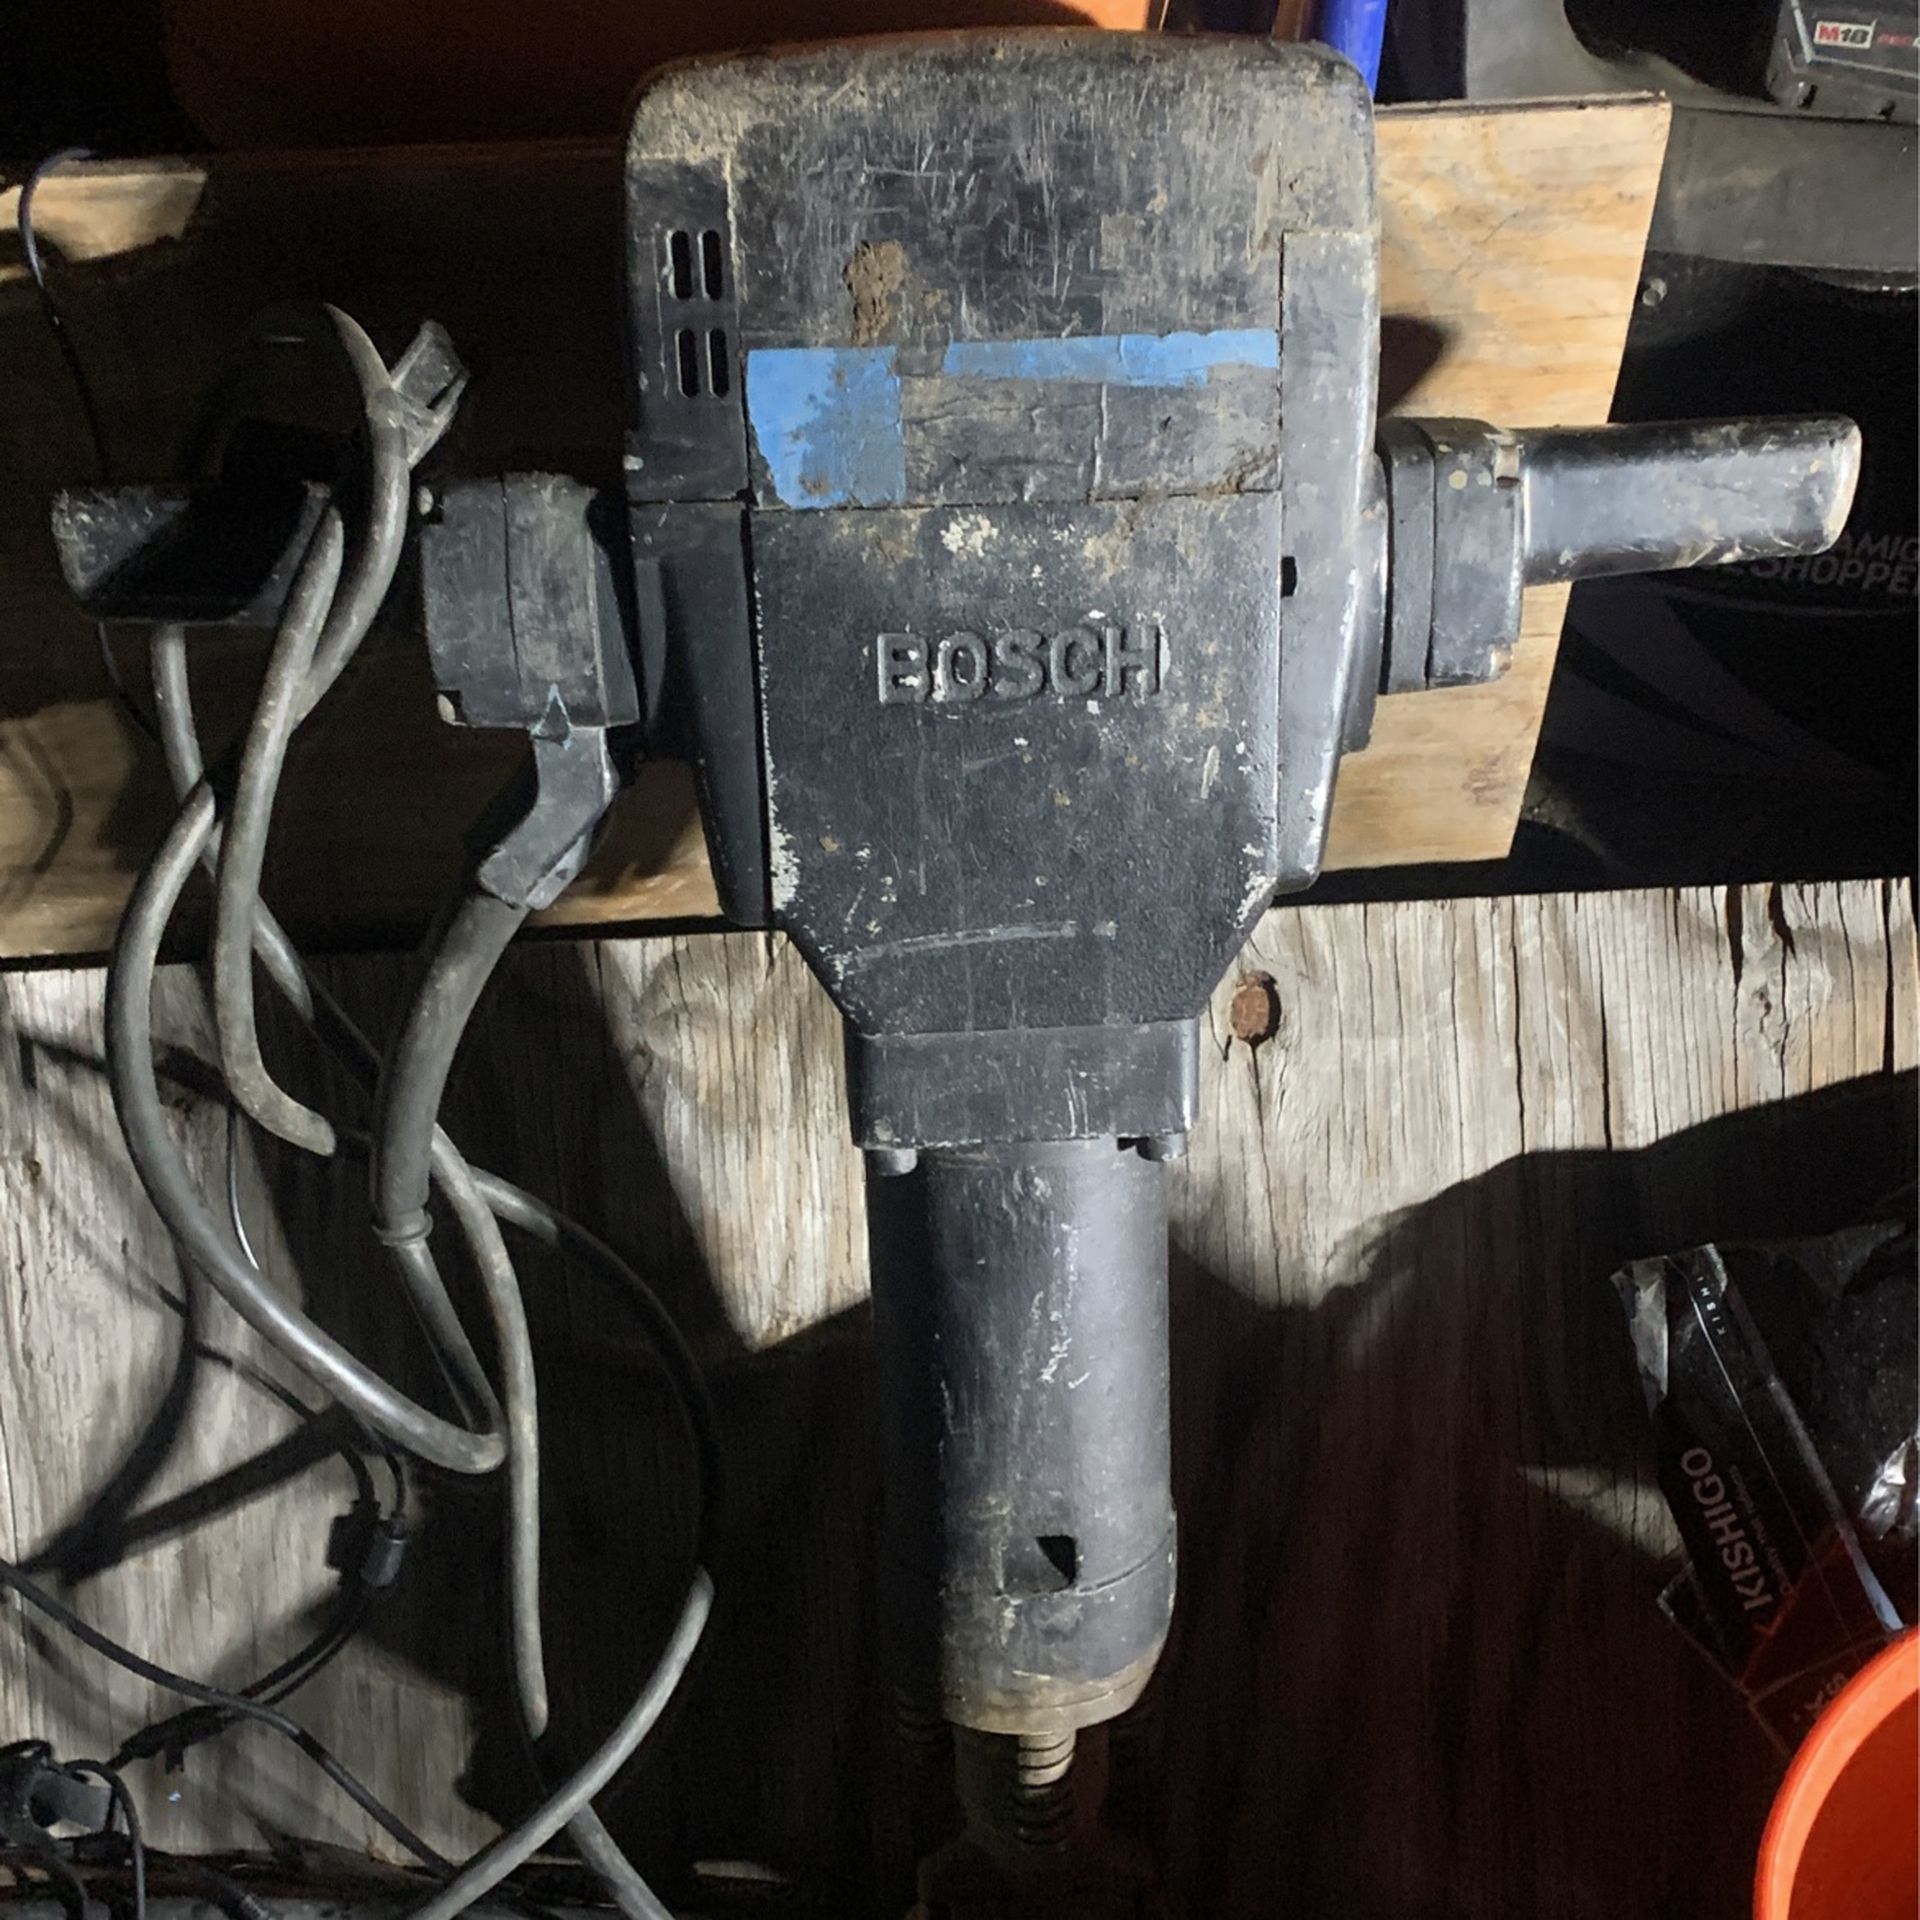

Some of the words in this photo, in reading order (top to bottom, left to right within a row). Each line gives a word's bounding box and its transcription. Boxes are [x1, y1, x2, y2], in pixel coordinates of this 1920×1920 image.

[1818, 24, 1869, 45] M18
[876, 624, 1163, 704] BOSCH
[1680, 1447, 1774, 1611] KISHIGO
